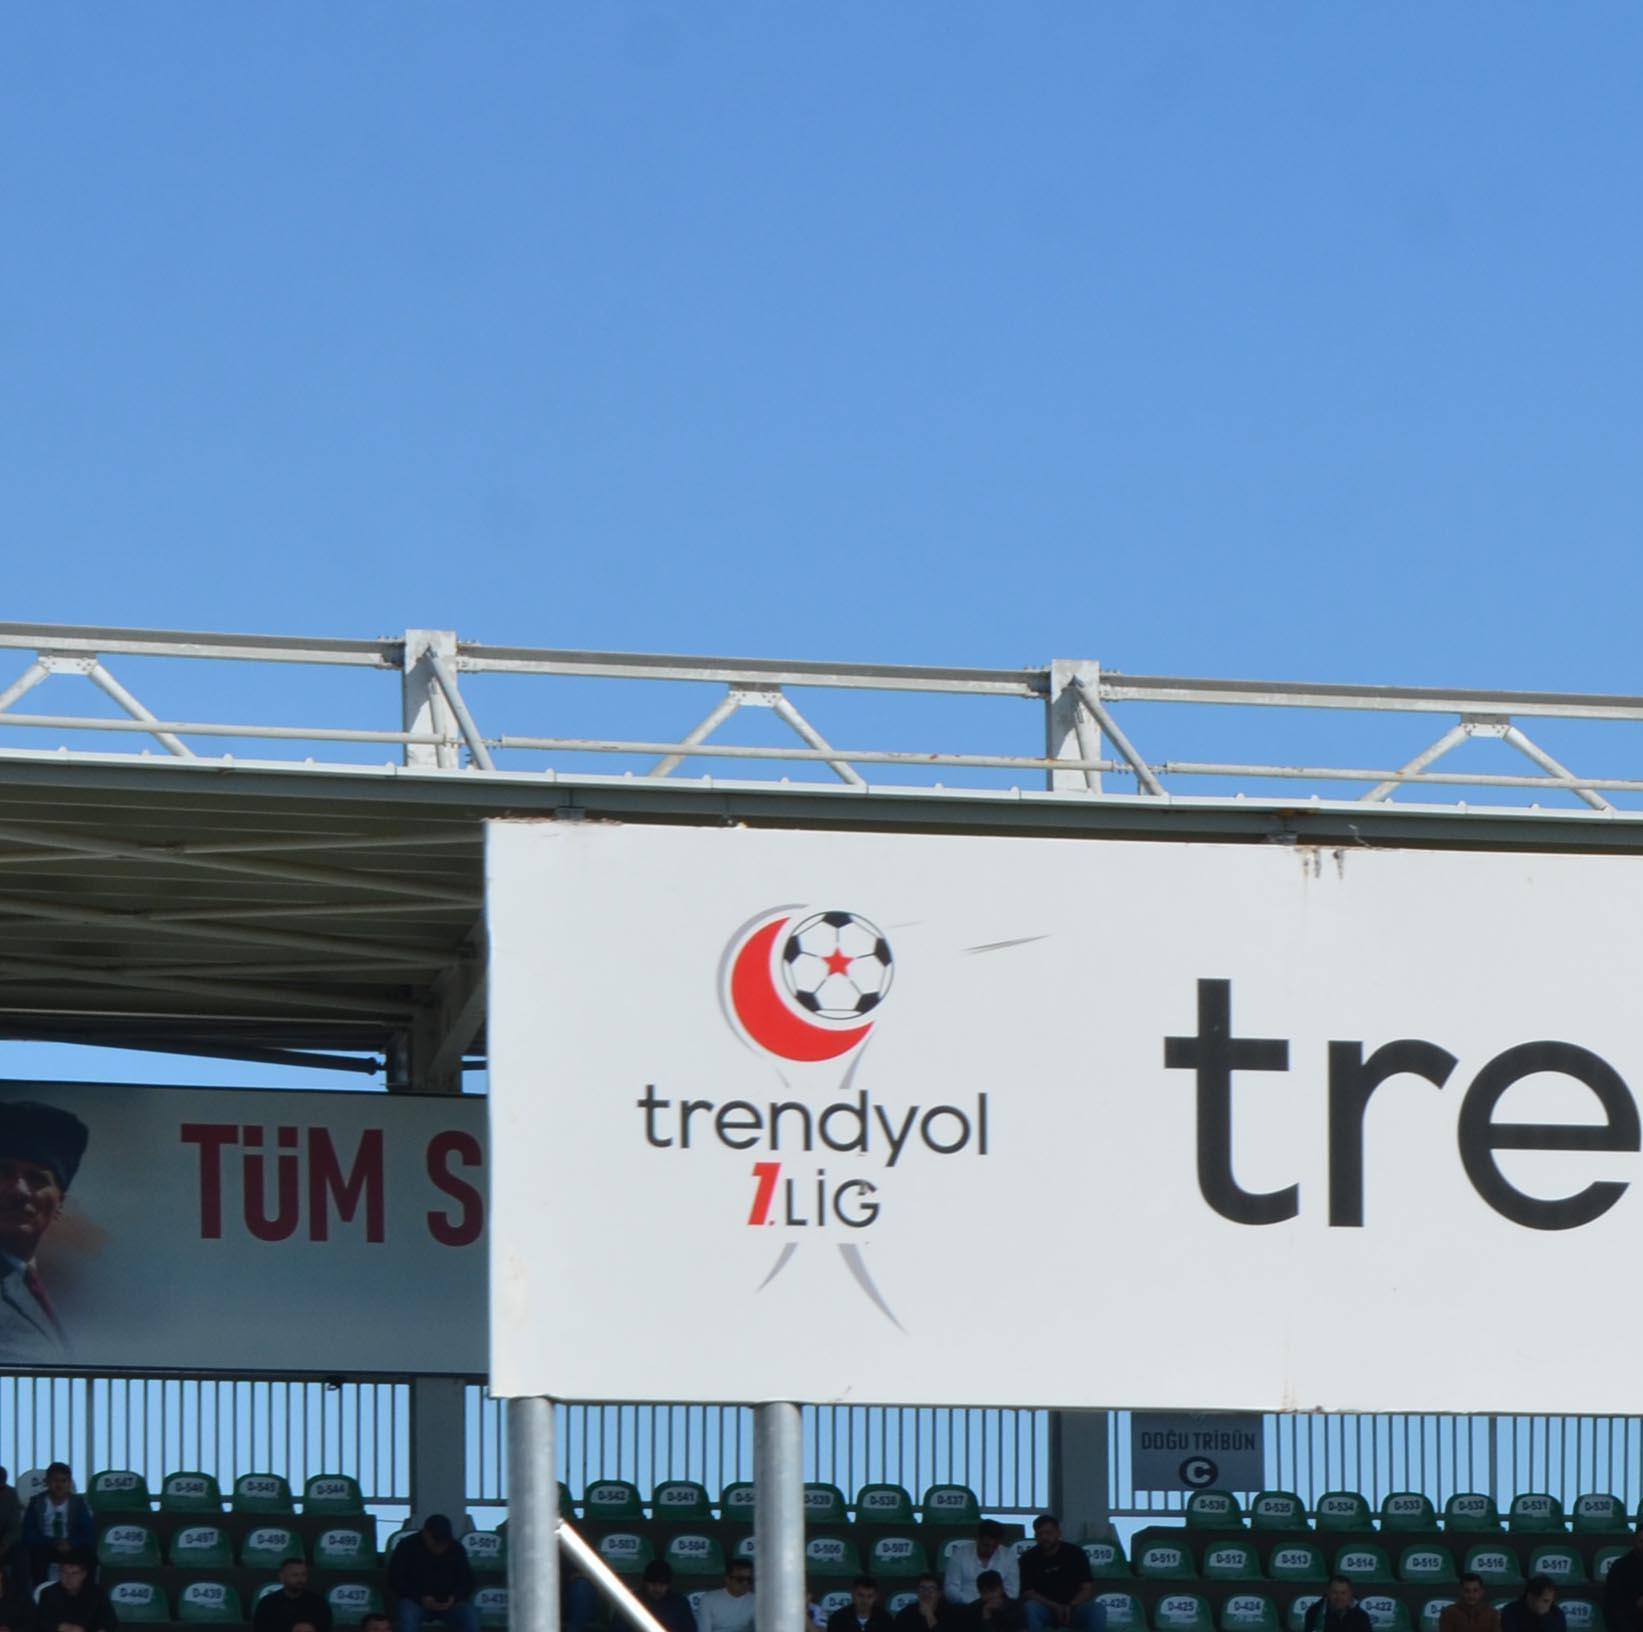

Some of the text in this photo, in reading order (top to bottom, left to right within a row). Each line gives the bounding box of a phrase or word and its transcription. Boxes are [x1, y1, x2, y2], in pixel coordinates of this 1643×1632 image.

[637, 1085, 988, 1167] trendyol
[181, 1123, 385, 1244] TÜM
[1141, 1429, 1256, 1450] DOĞU TRİBÜN
[1186, 1461, 1212, 1484] C
